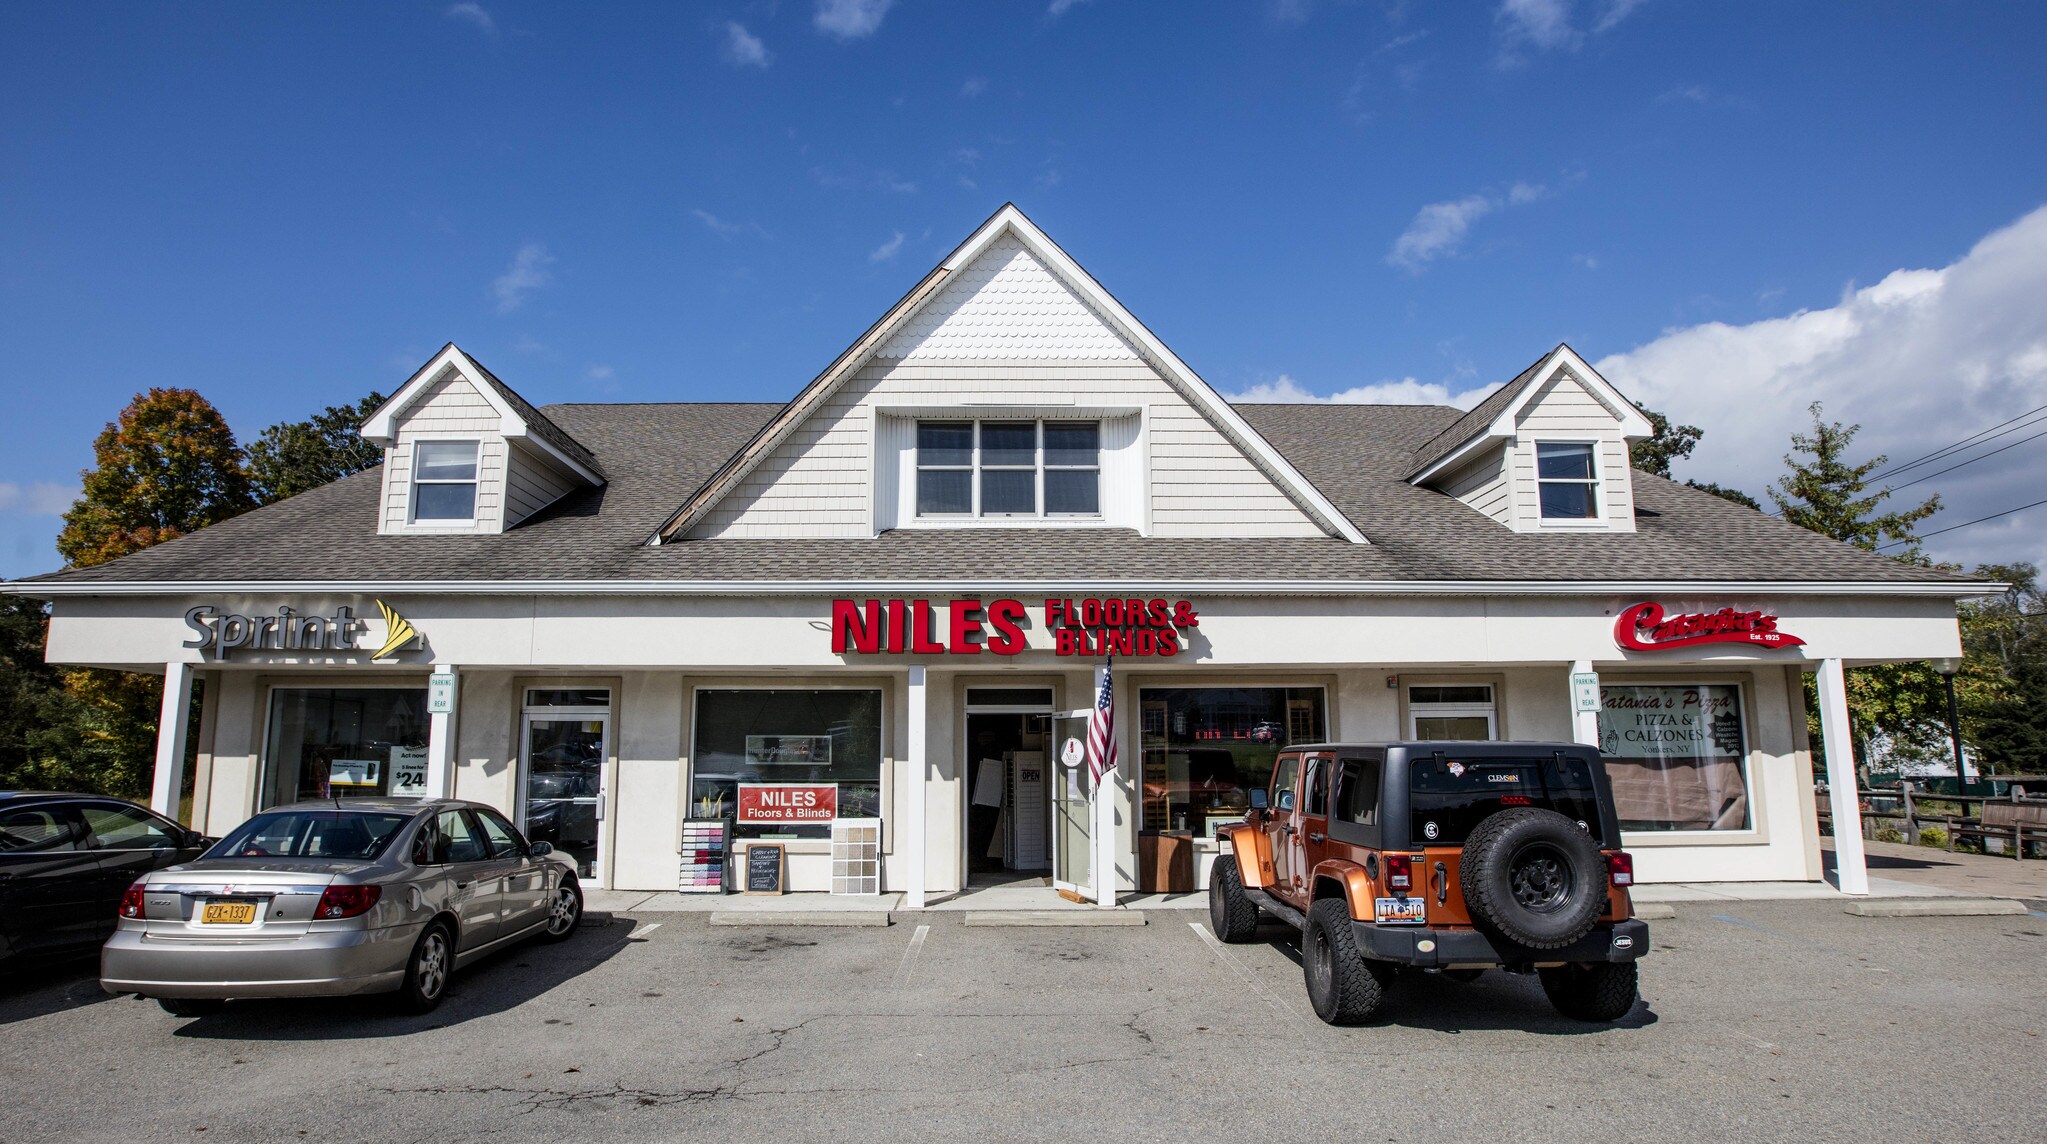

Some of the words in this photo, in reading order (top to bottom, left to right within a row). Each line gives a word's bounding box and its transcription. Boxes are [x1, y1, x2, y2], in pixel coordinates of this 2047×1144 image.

[183, 605, 356, 660] Sprint
[832, 599, 1026, 655] NILES
[1614, 602, 1779, 650] Catania's
[1056, 628, 1178, 656] BLINDS
[1682, 689, 1731, 715] Pizza
[1636, 714, 1679, 726] PIZZA
[1682, 713, 1693, 726] &
[1624, 729, 1704, 742] CALZONES
[1677, 745, 1691, 753] NY
[1022, 771, 1040, 780] OPEN
[761, 791, 816, 807] NILES
[747, 808, 782, 818] Floors
[785, 808, 794, 818] &
[797, 808, 832, 818] Blinds
[206, 906, 223, 918] GZX
[229, 906, 251, 918] 1337
[1378, 904, 1396, 916] LIA
[1405, 904, 1422, 917] 510
